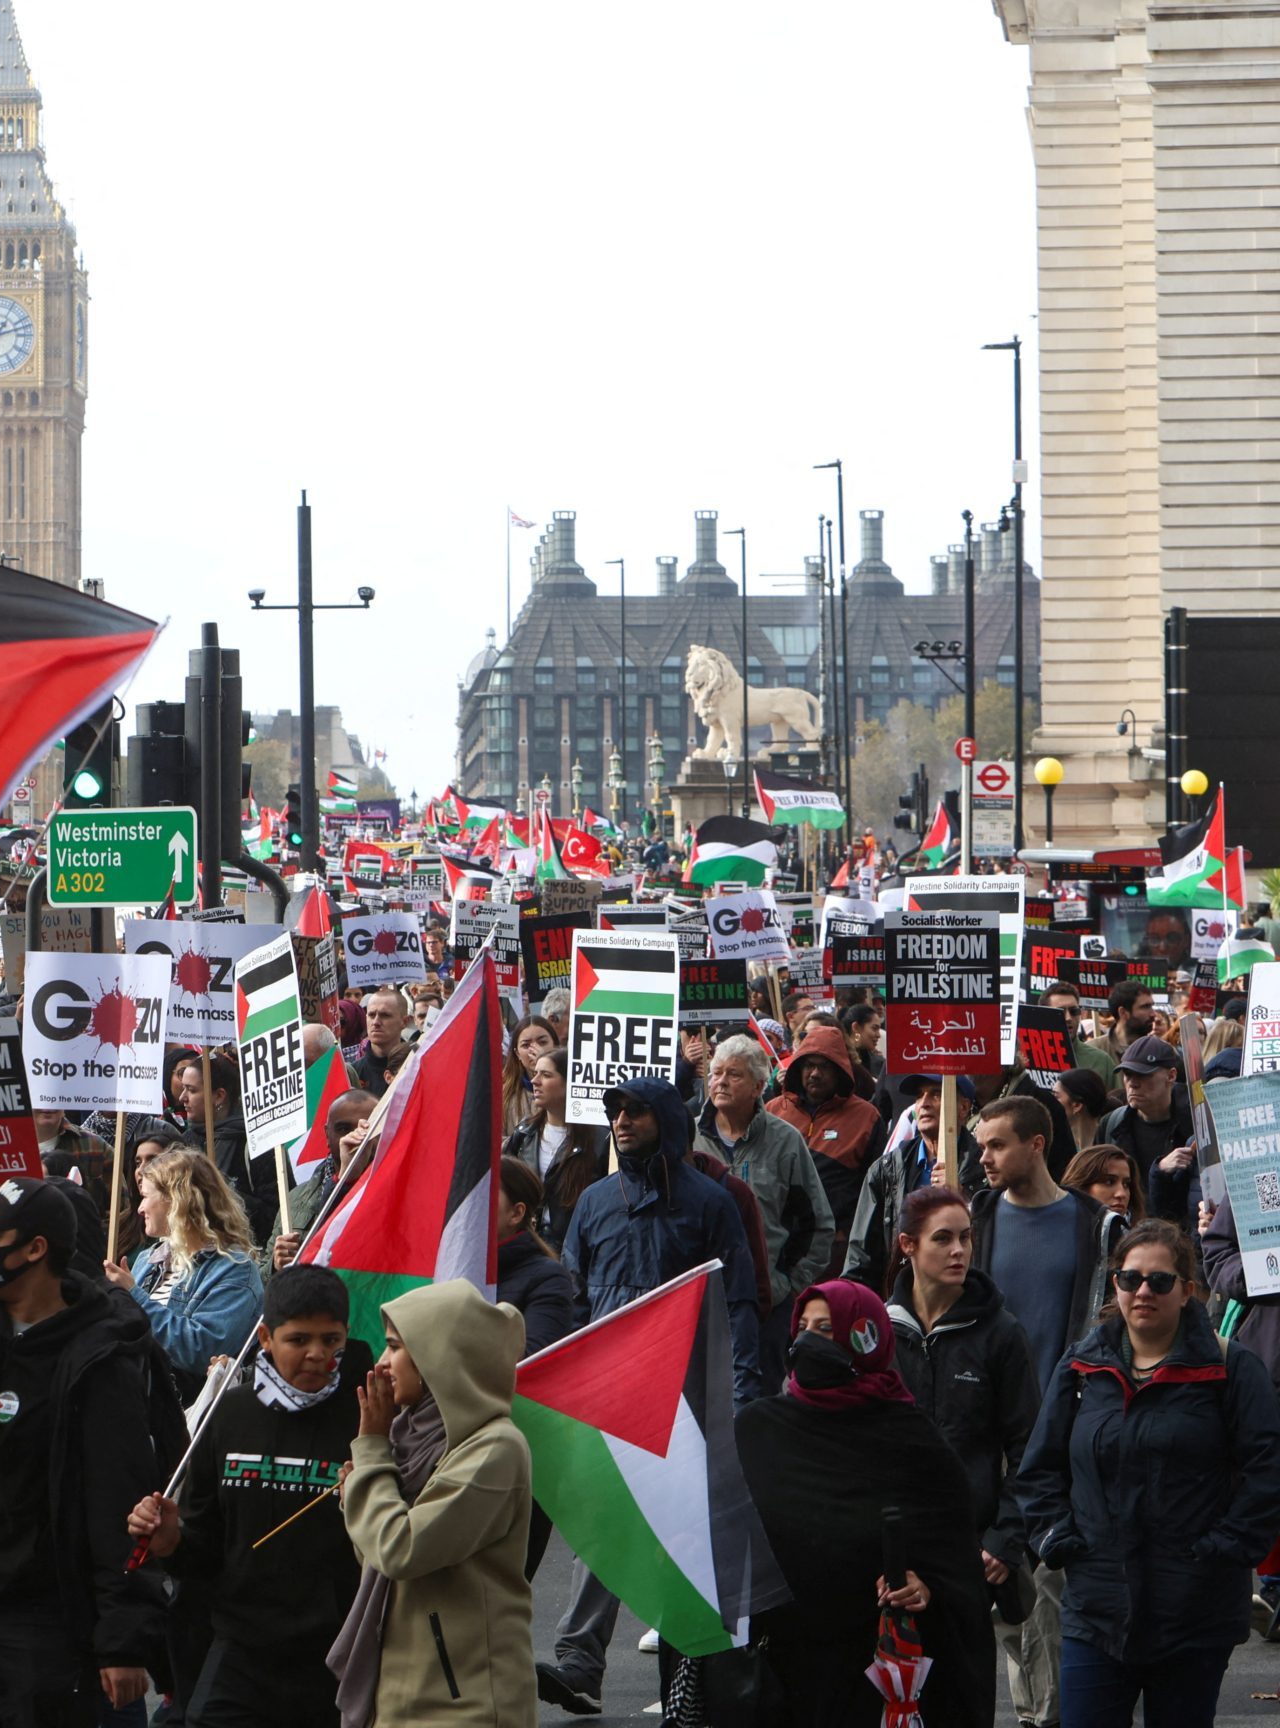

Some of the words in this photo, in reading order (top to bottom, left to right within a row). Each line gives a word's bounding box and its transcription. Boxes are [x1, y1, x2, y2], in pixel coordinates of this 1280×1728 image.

[961, 741, 972, 758] E
[56, 821, 162, 842] Westminster
[55, 848, 122, 867] Victoria
[411, 875, 441, 885] FREE
[910, 882, 942, 891] Palestine
[943, 881, 979, 890] Solidarity
[981, 881, 1020, 890] Campaign
[1026, 903, 1052, 917] STOP
[831, 920, 869, 935] FREEDOM
[347, 928, 419, 956] Gza
[457, 935, 479, 946] STOP
[498, 939, 517, 952] WAR
[577, 934, 608, 945] Palestine
[609, 936, 641, 947] Solidarity
[642, 938, 675, 948] Campaign
[678, 933, 704, 944] EEDOM
[719, 942, 740, 954] Stop
[741, 938, 756, 948] the
[896, 934, 987, 960] FREEDOM
[351, 963, 371, 974] Stop
[372, 962, 388, 971] the
[935, 960, 950, 972] for
[1080, 961, 1107, 973] STOP
[1127, 963, 1149, 975] REE
[1200, 964, 1218, 975] FREE
[892, 973, 993, 999] PALESTINE
[1079, 973, 1108, 986] GAZA
[1195, 976, 1218, 988] PALES
[684, 983, 745, 1000] ESTINE
[32, 979, 162, 1044] Gza
[173, 1004, 194, 1019] the
[197, 1008, 235, 1021] mass
[910, 1010, 976, 1036] الحرية
[1253, 1023, 1280, 1038] EXI
[573, 1014, 674, 1066] FREE
[1253, 1040, 1280, 1056] RES
[902, 1036, 986, 1061] لفلسطين
[1017, 1028, 1071, 1070] FREE
[240, 1021, 302, 1094] FREE
[32, 1058, 77, 1080] Stop
[83, 1059, 115, 1078] the
[40, 1095, 57, 1104] Stop
[59, 1095, 72, 1103] the
[245, 1071, 303, 1117] PALESTINE
[572, 1087, 587, 1098] END
[1238, 1104, 1276, 1129] FREE
[1222, 1134, 1280, 1162] PALESTI
[1249, 1228, 1260, 1236] SCAN
[221, 1479, 251, 1487] FREE
